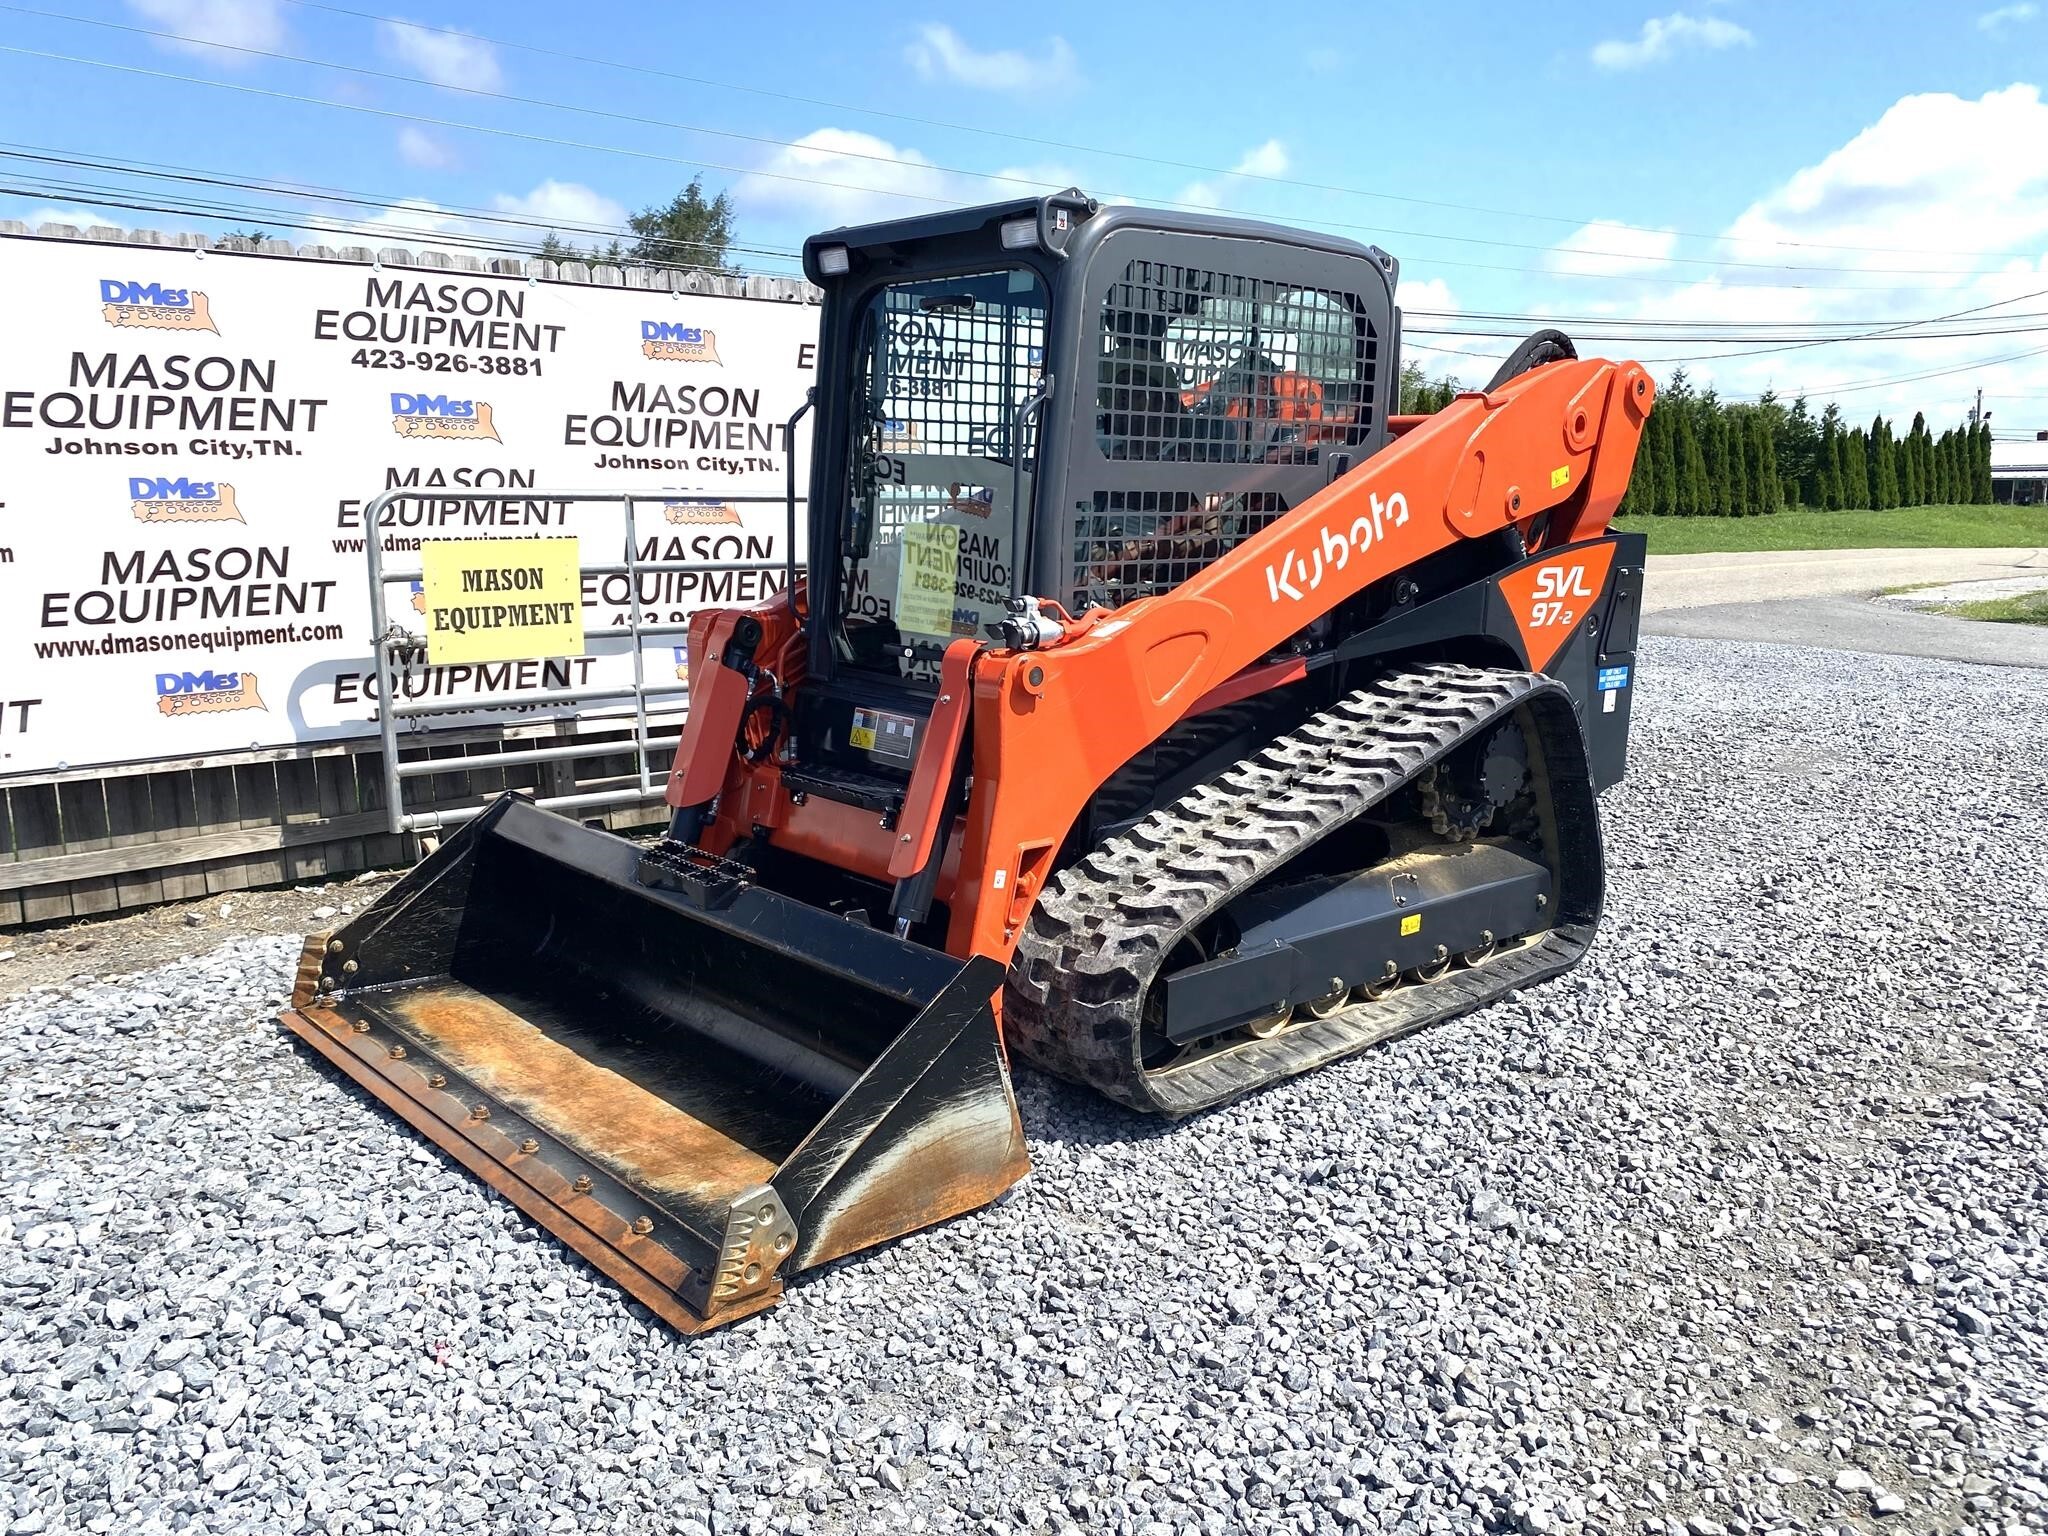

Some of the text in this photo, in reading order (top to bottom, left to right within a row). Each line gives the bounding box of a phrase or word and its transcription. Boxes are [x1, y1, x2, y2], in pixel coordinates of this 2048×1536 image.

[365, 277, 525, 319] MASON
[314, 309, 566, 353] EQUIPMENT
[69, 351, 276, 393] MASON
[350, 348, 543, 377] 423-926-3881
[2, 391, 328, 432] EQUIPMENT
[611, 380, 760, 418] MASON
[45, 437, 178, 456] Johnson
[594, 453, 690, 471] Johnson
[337, 499, 574, 528] EQUIPMENT
[101, 546, 290, 586] MASON
[1265, 491, 1410, 604] Kubota
[461, 567, 544, 593] MASON
[1531, 565, 1593, 600] SVL
[40, 580, 337, 629] EQUIPMENT
[432, 602, 575, 635] EQUIPMENT
[1529, 602, 1574, 628] 97-2
[34, 620, 344, 660] www.dmasonequipment.com
[333, 657, 597, 704] EQUIPMENT
